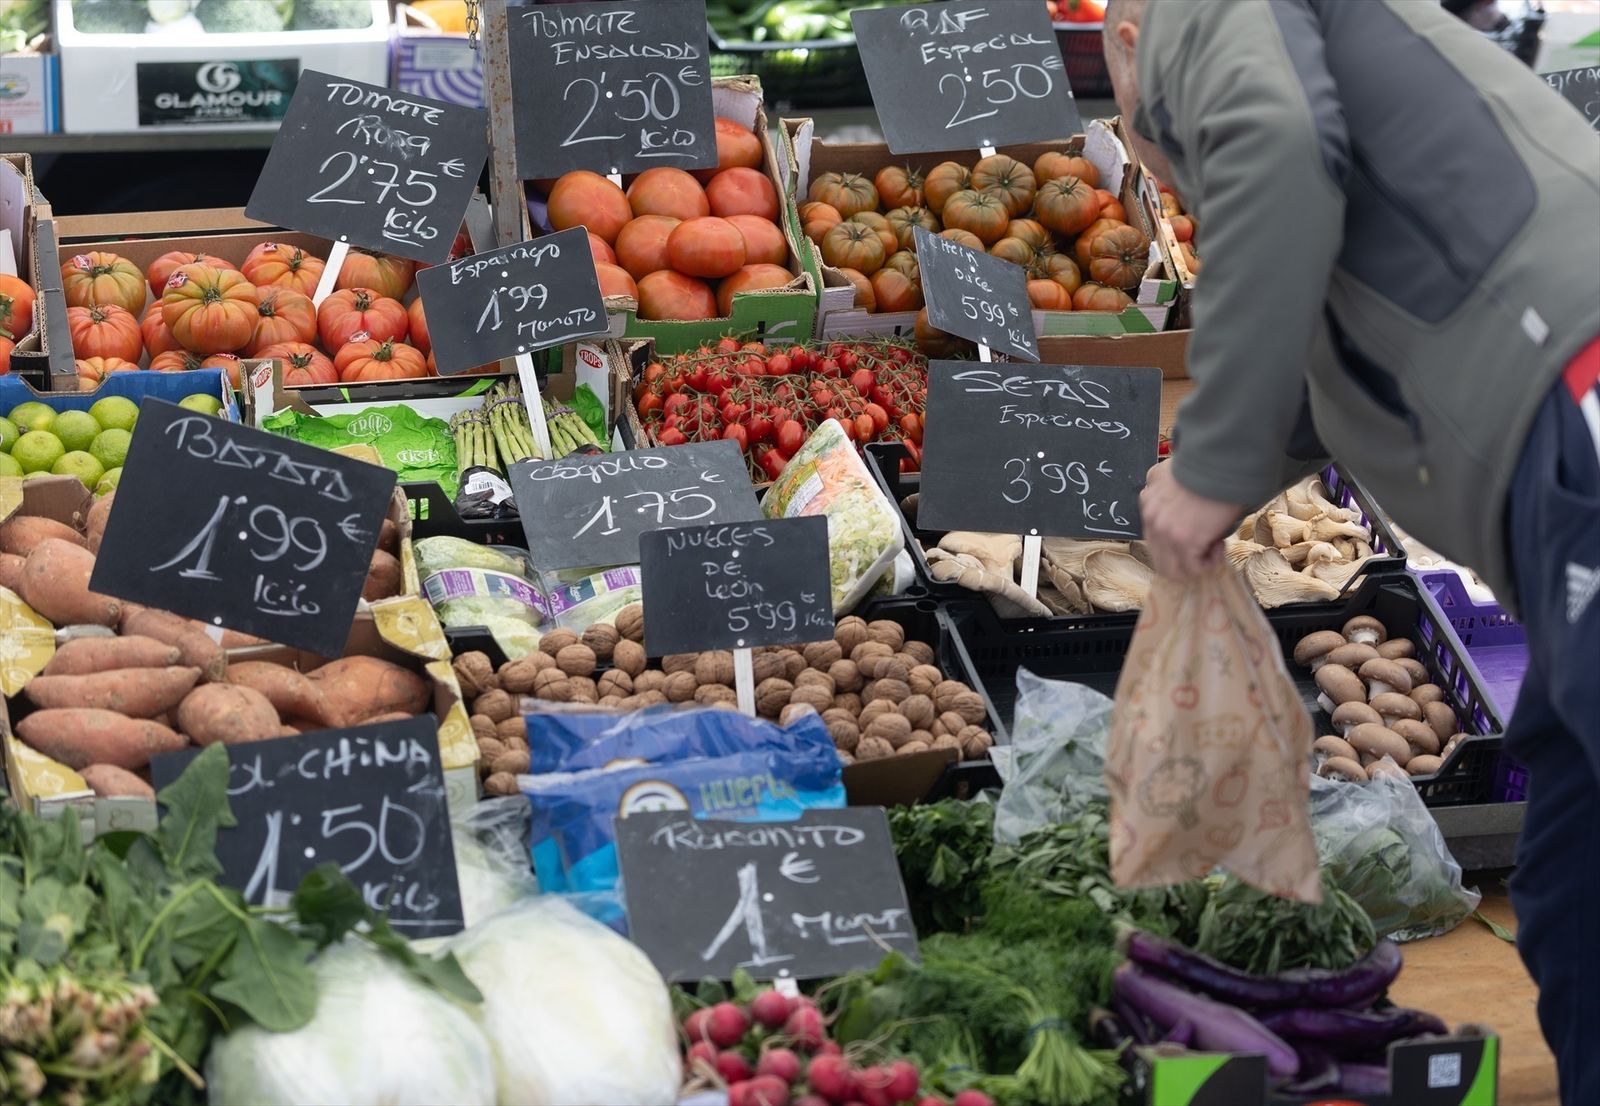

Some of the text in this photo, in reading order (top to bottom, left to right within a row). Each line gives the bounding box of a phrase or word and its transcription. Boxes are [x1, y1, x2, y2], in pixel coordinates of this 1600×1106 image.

[550, 42, 700, 65] ENSALADA
[155, 90, 282, 109] GLAMOUR
[581, 350, 602, 368] TROPS
[952, 370, 1110, 409] SETAS
[165, 416, 352, 502] BATATA
